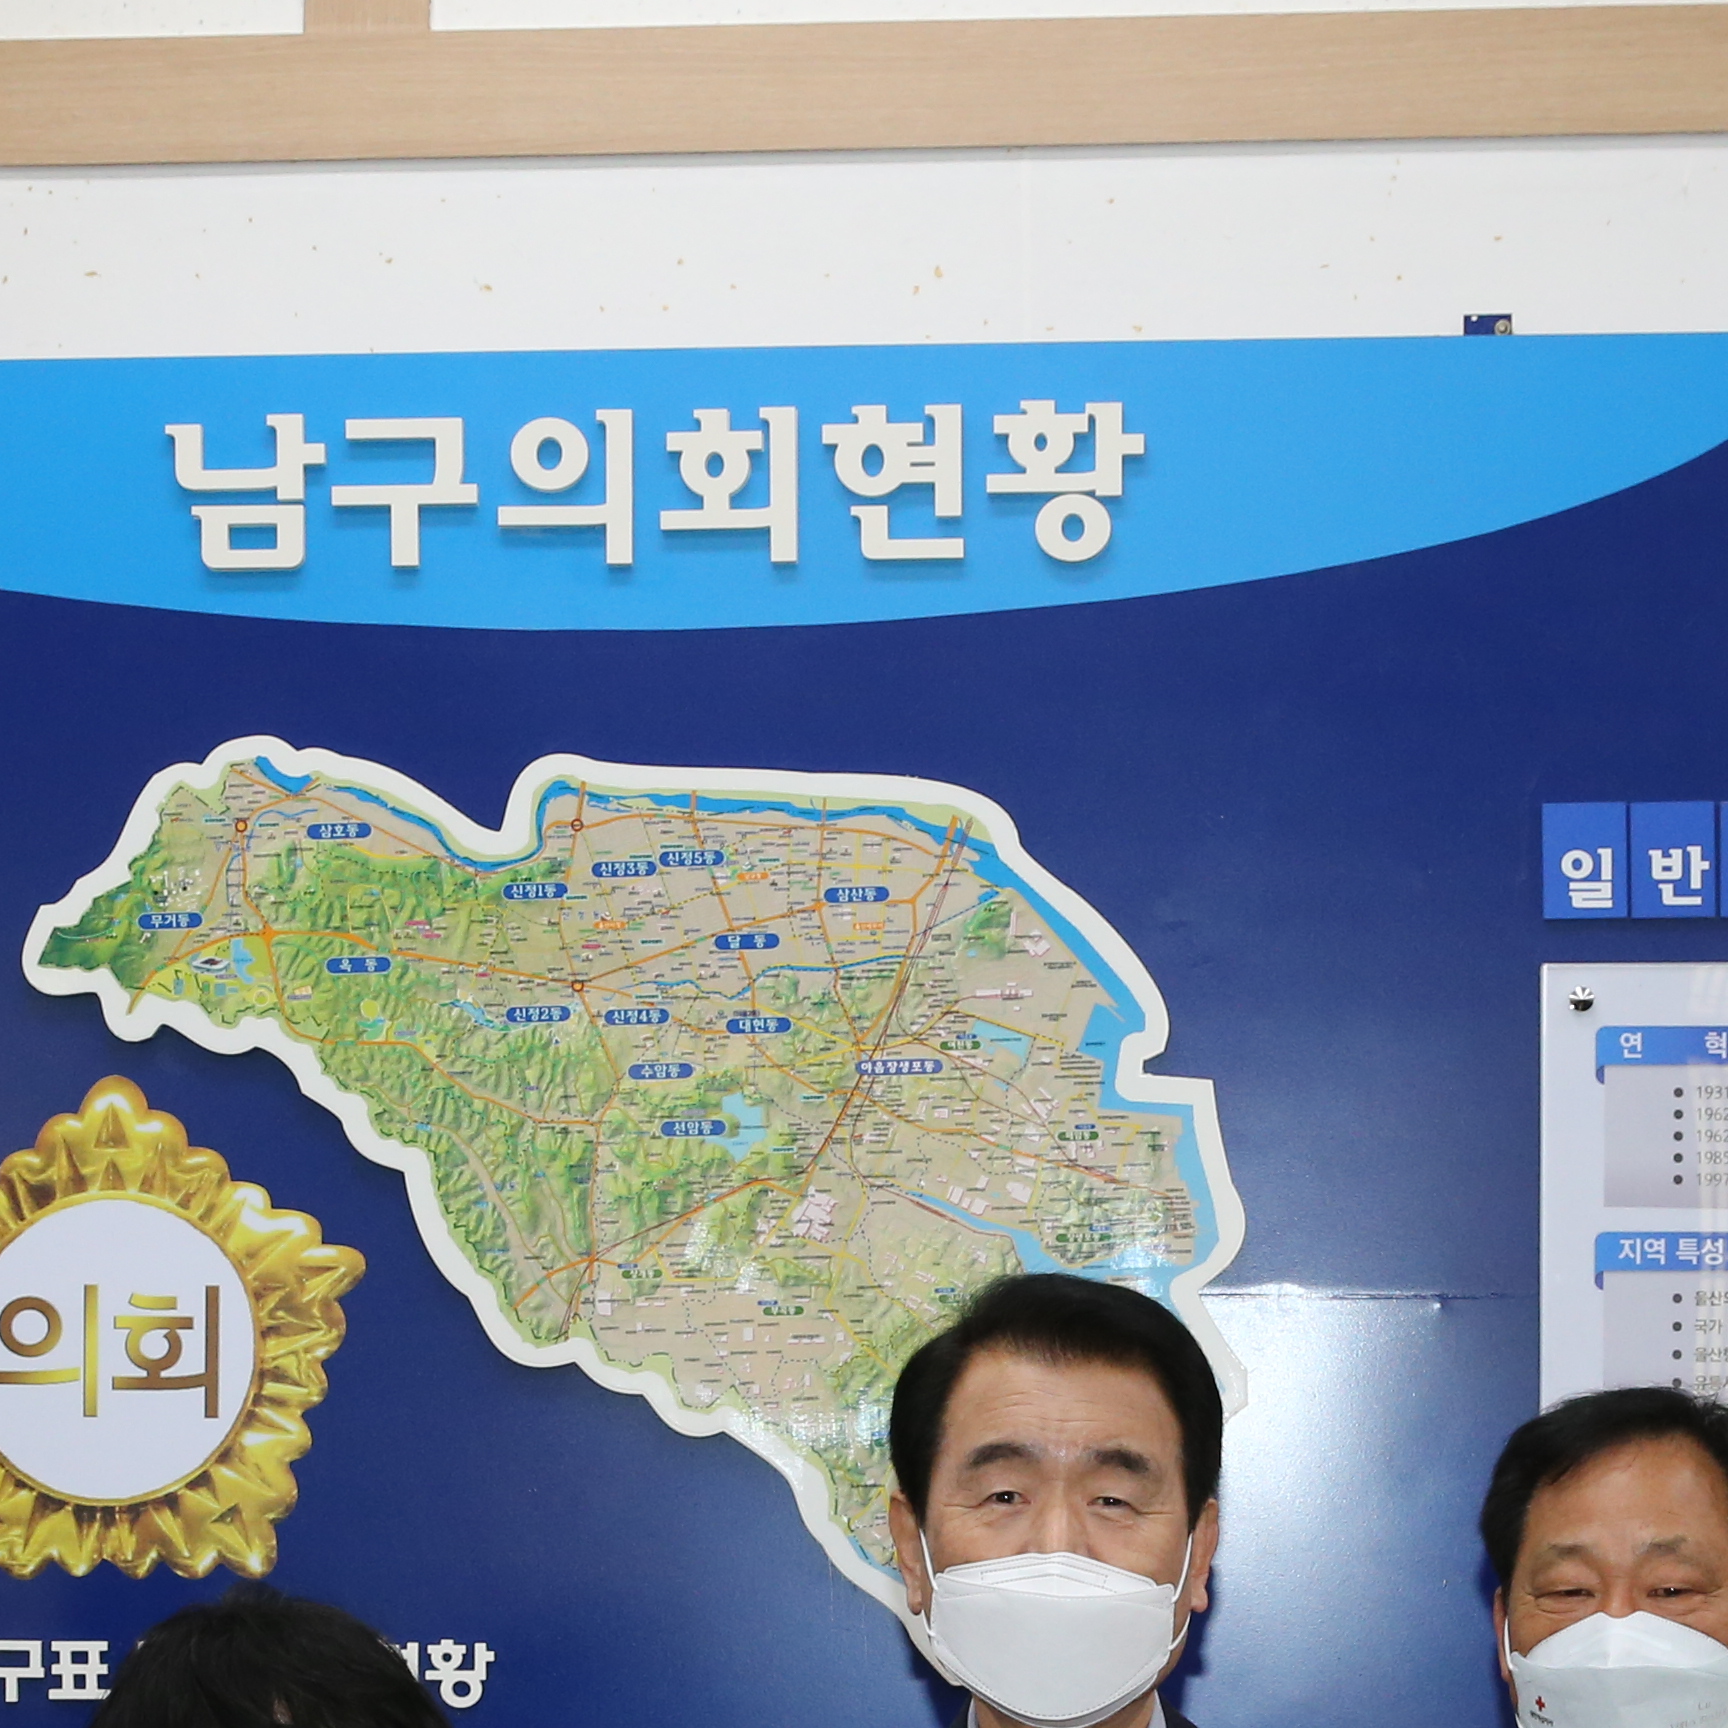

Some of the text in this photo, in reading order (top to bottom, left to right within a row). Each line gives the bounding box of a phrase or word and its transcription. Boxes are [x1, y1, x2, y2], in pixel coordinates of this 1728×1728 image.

[165, 400, 1144, 570] 남구의회현황
[319, 823, 360, 839] 삼호동
[666, 852, 716, 866] 신정5동
[600, 862, 648, 876] 신정3동
[510, 883, 556, 899] 신정1동
[837, 887, 878, 902] 삼산동
[150, 913, 190, 929] 무거동
[339, 958, 378, 973] 옥동
[514, 1006, 563, 1021] 신정2동
[612, 1009, 661, 1024] 신정4동
[739, 1018, 778, 1032] 대현동
[641, 1064, 681, 1078] 수암동
[673, 1121, 714, 1136] 선암동
[1618, 1238, 1724, 1265] 지역 특성
[1694, 1319, 1722, 1335] 국가
